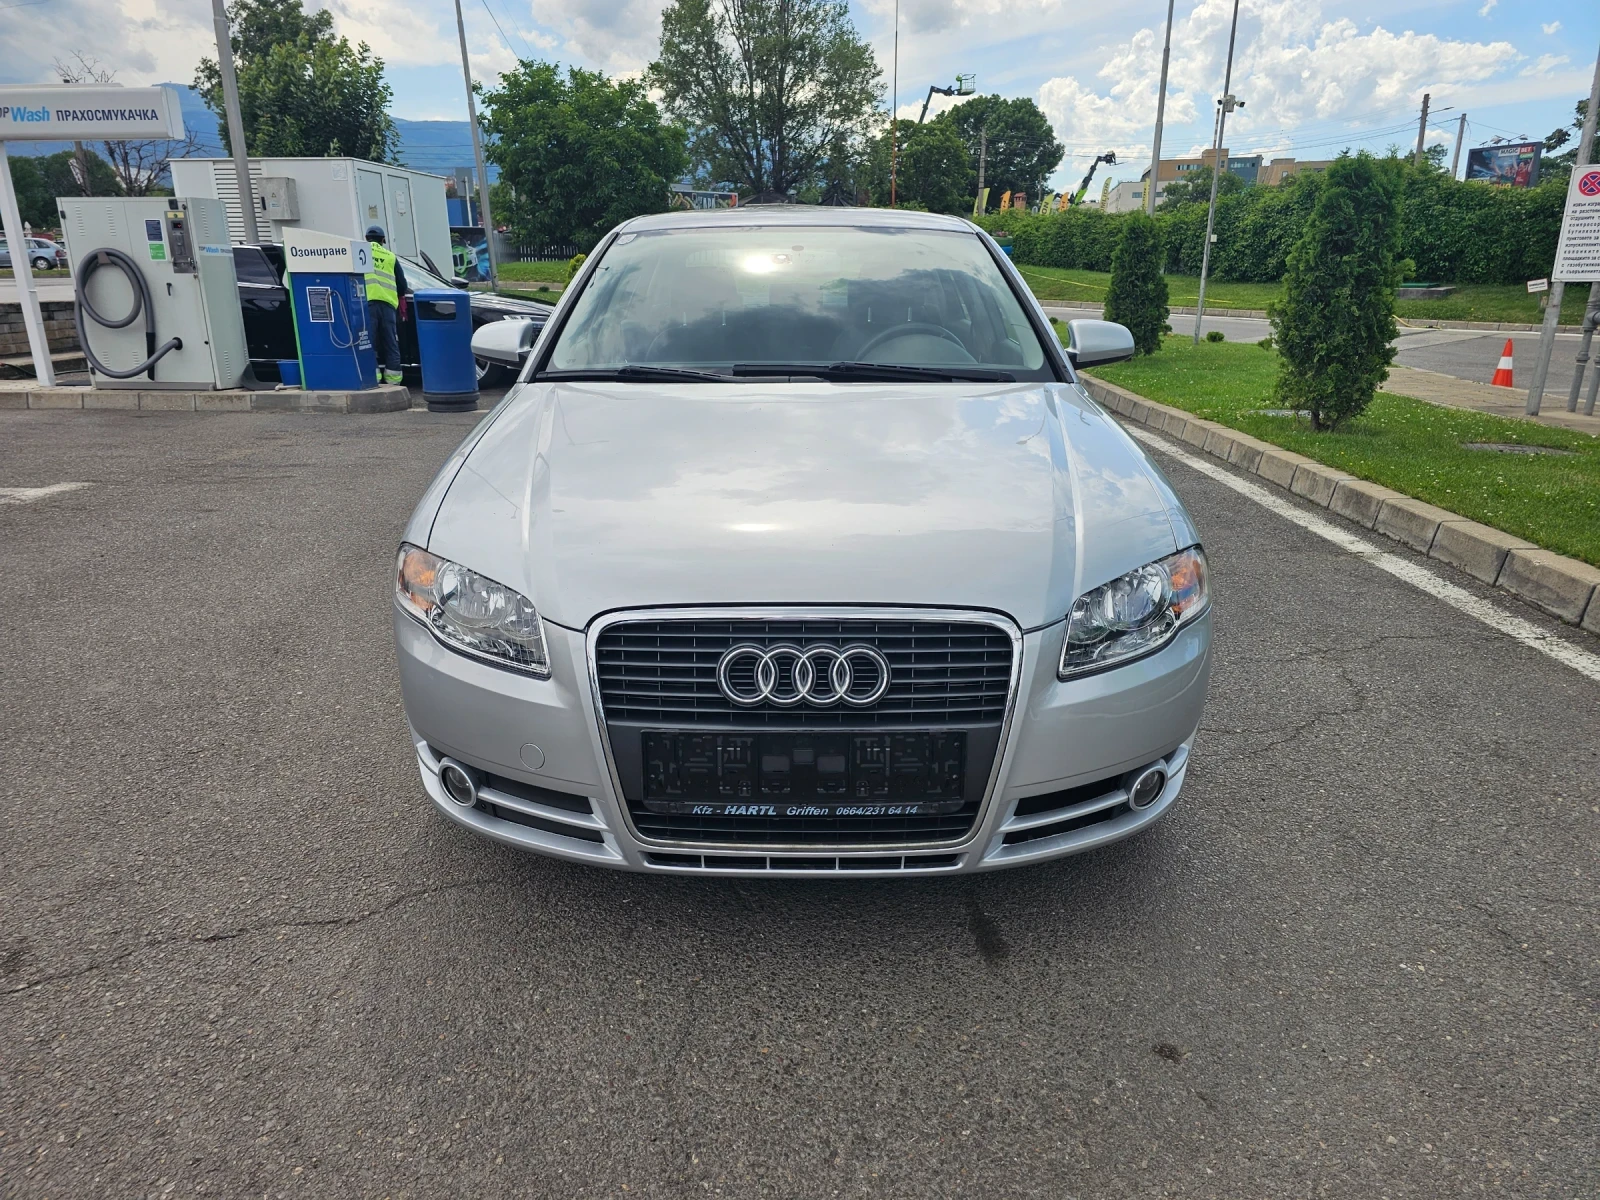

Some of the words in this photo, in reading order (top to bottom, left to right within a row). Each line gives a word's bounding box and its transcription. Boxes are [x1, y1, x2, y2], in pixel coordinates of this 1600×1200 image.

[56, 109, 159, 121] ПРАХОСМУКАЧКА
[290, 246, 347, 258] Озониране
[692, 805, 713, 815] Kfz
[724, 805, 777, 815] HARTL
[786, 806, 829, 816] Griffen
[836, 806, 885, 816] 0664/231
[888, 806, 902, 815] 64
[905, 805, 918, 814] 14
